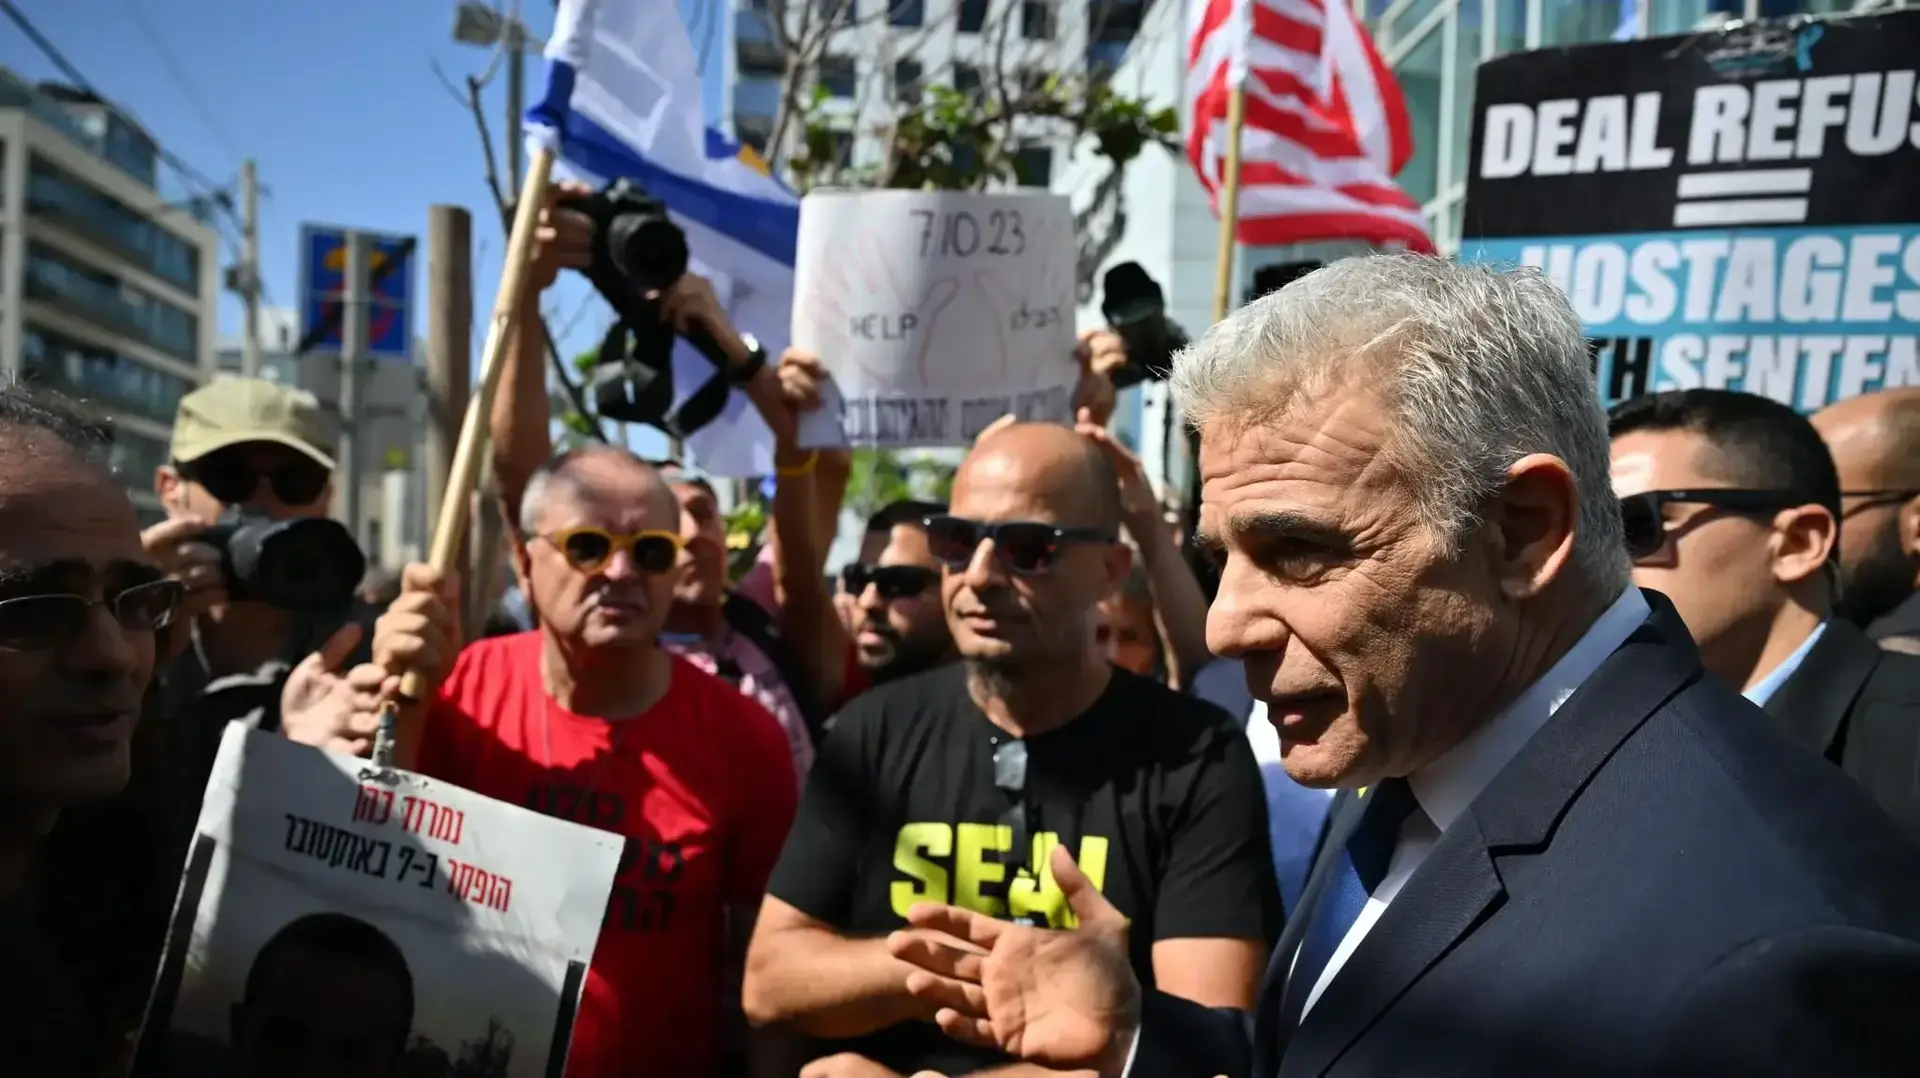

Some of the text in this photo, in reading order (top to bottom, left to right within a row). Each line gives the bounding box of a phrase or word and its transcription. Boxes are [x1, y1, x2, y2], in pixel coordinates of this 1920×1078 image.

[1480, 70, 1920, 179] DEAL REFU
[849, 312, 920, 341] HELP
[352, 785, 465, 845] נמרוד כהן
[285, 813, 392, 878] באוקטובר
[447, 858, 512, 912] הופקר
